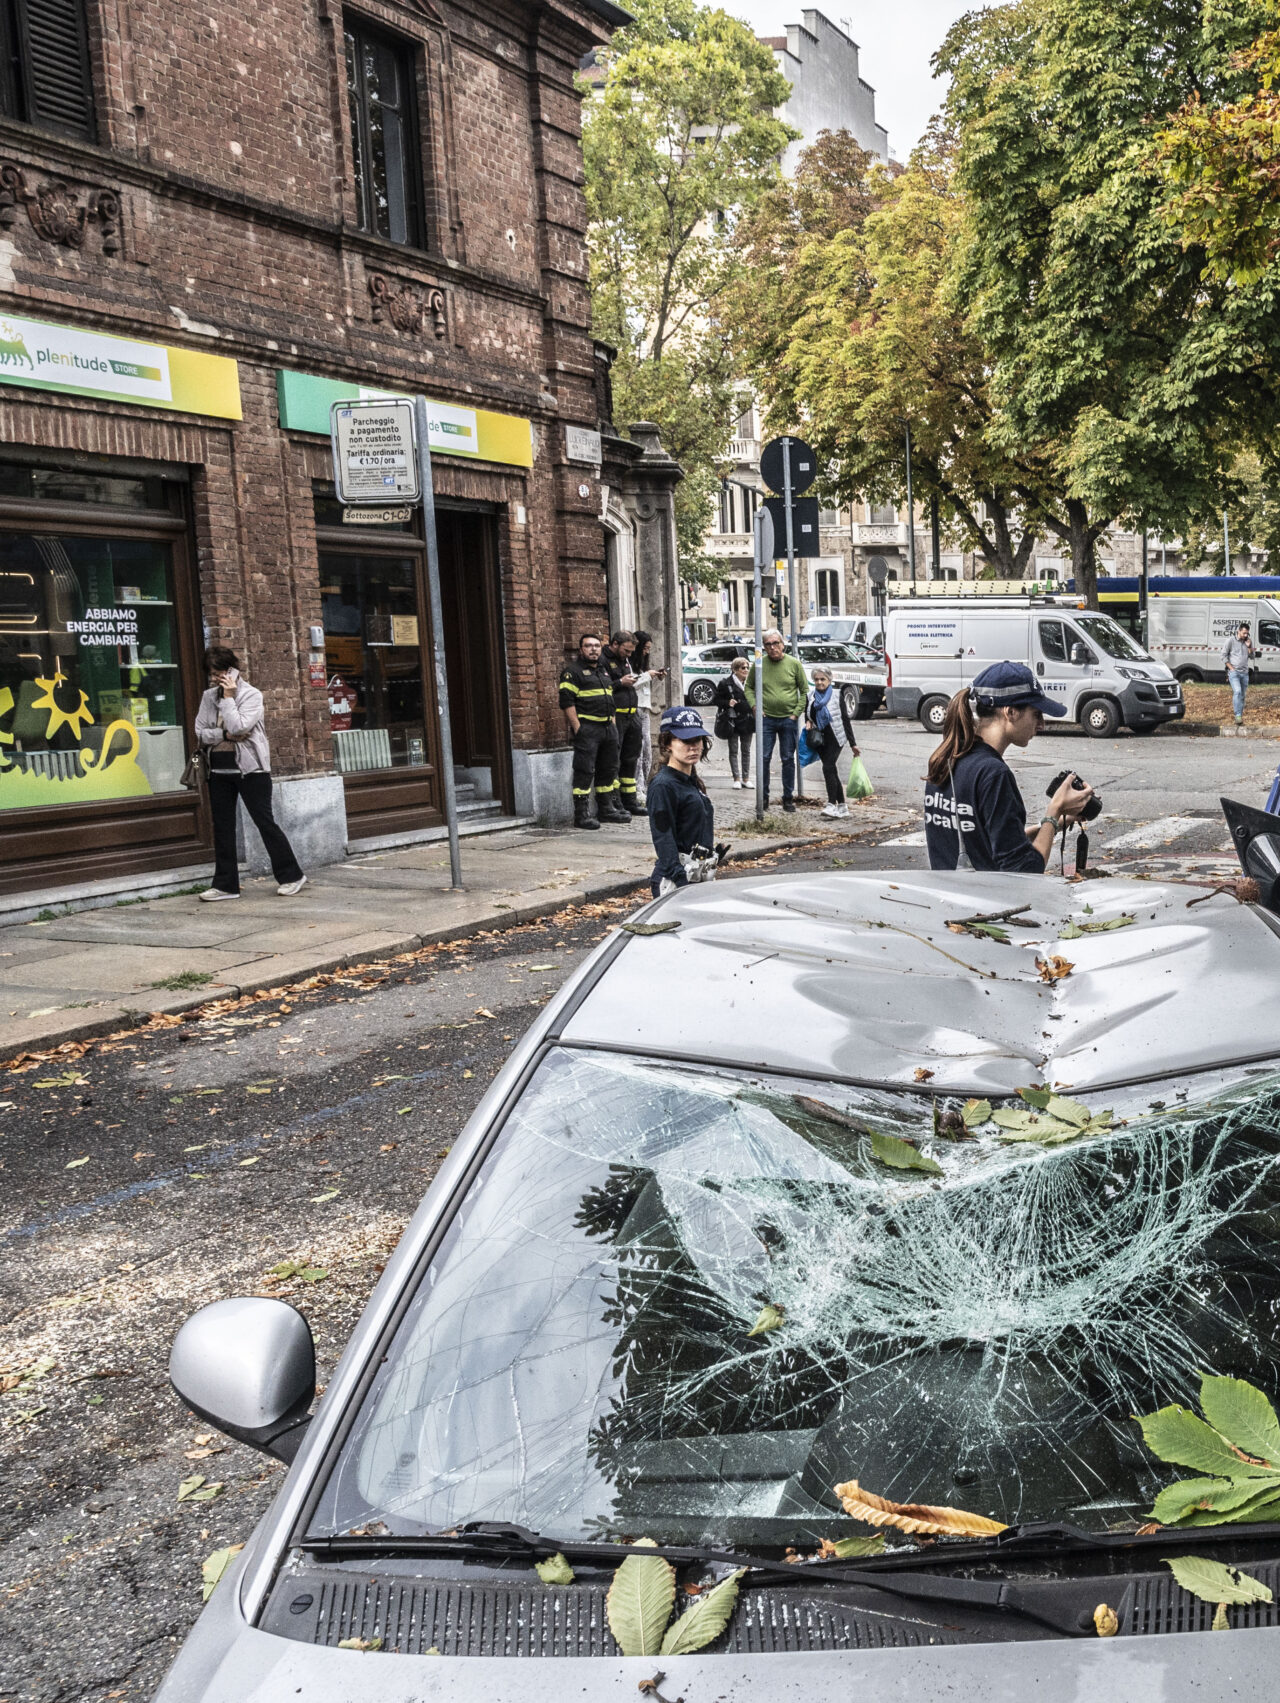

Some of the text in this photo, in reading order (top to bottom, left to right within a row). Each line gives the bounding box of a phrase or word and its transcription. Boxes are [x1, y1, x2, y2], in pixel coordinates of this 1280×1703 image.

[37, 348, 139, 376] plenitude STORE
[352, 417, 395, 426] Parcheggio
[357, 426, 400, 436] pagamento
[349, 434, 402, 444] non custodito
[346, 448, 407, 457] Tariffa ordinaria:
[345, 510, 410, 521] Sottozona C1-C2
[85, 608, 137, 620] ABBIAMO
[66, 621, 138, 633] ENERGIA PER
[80, 634, 140, 646] CAMBIARE.
[924, 791, 975, 817] olizia
[924, 812, 977, 833] ocale
